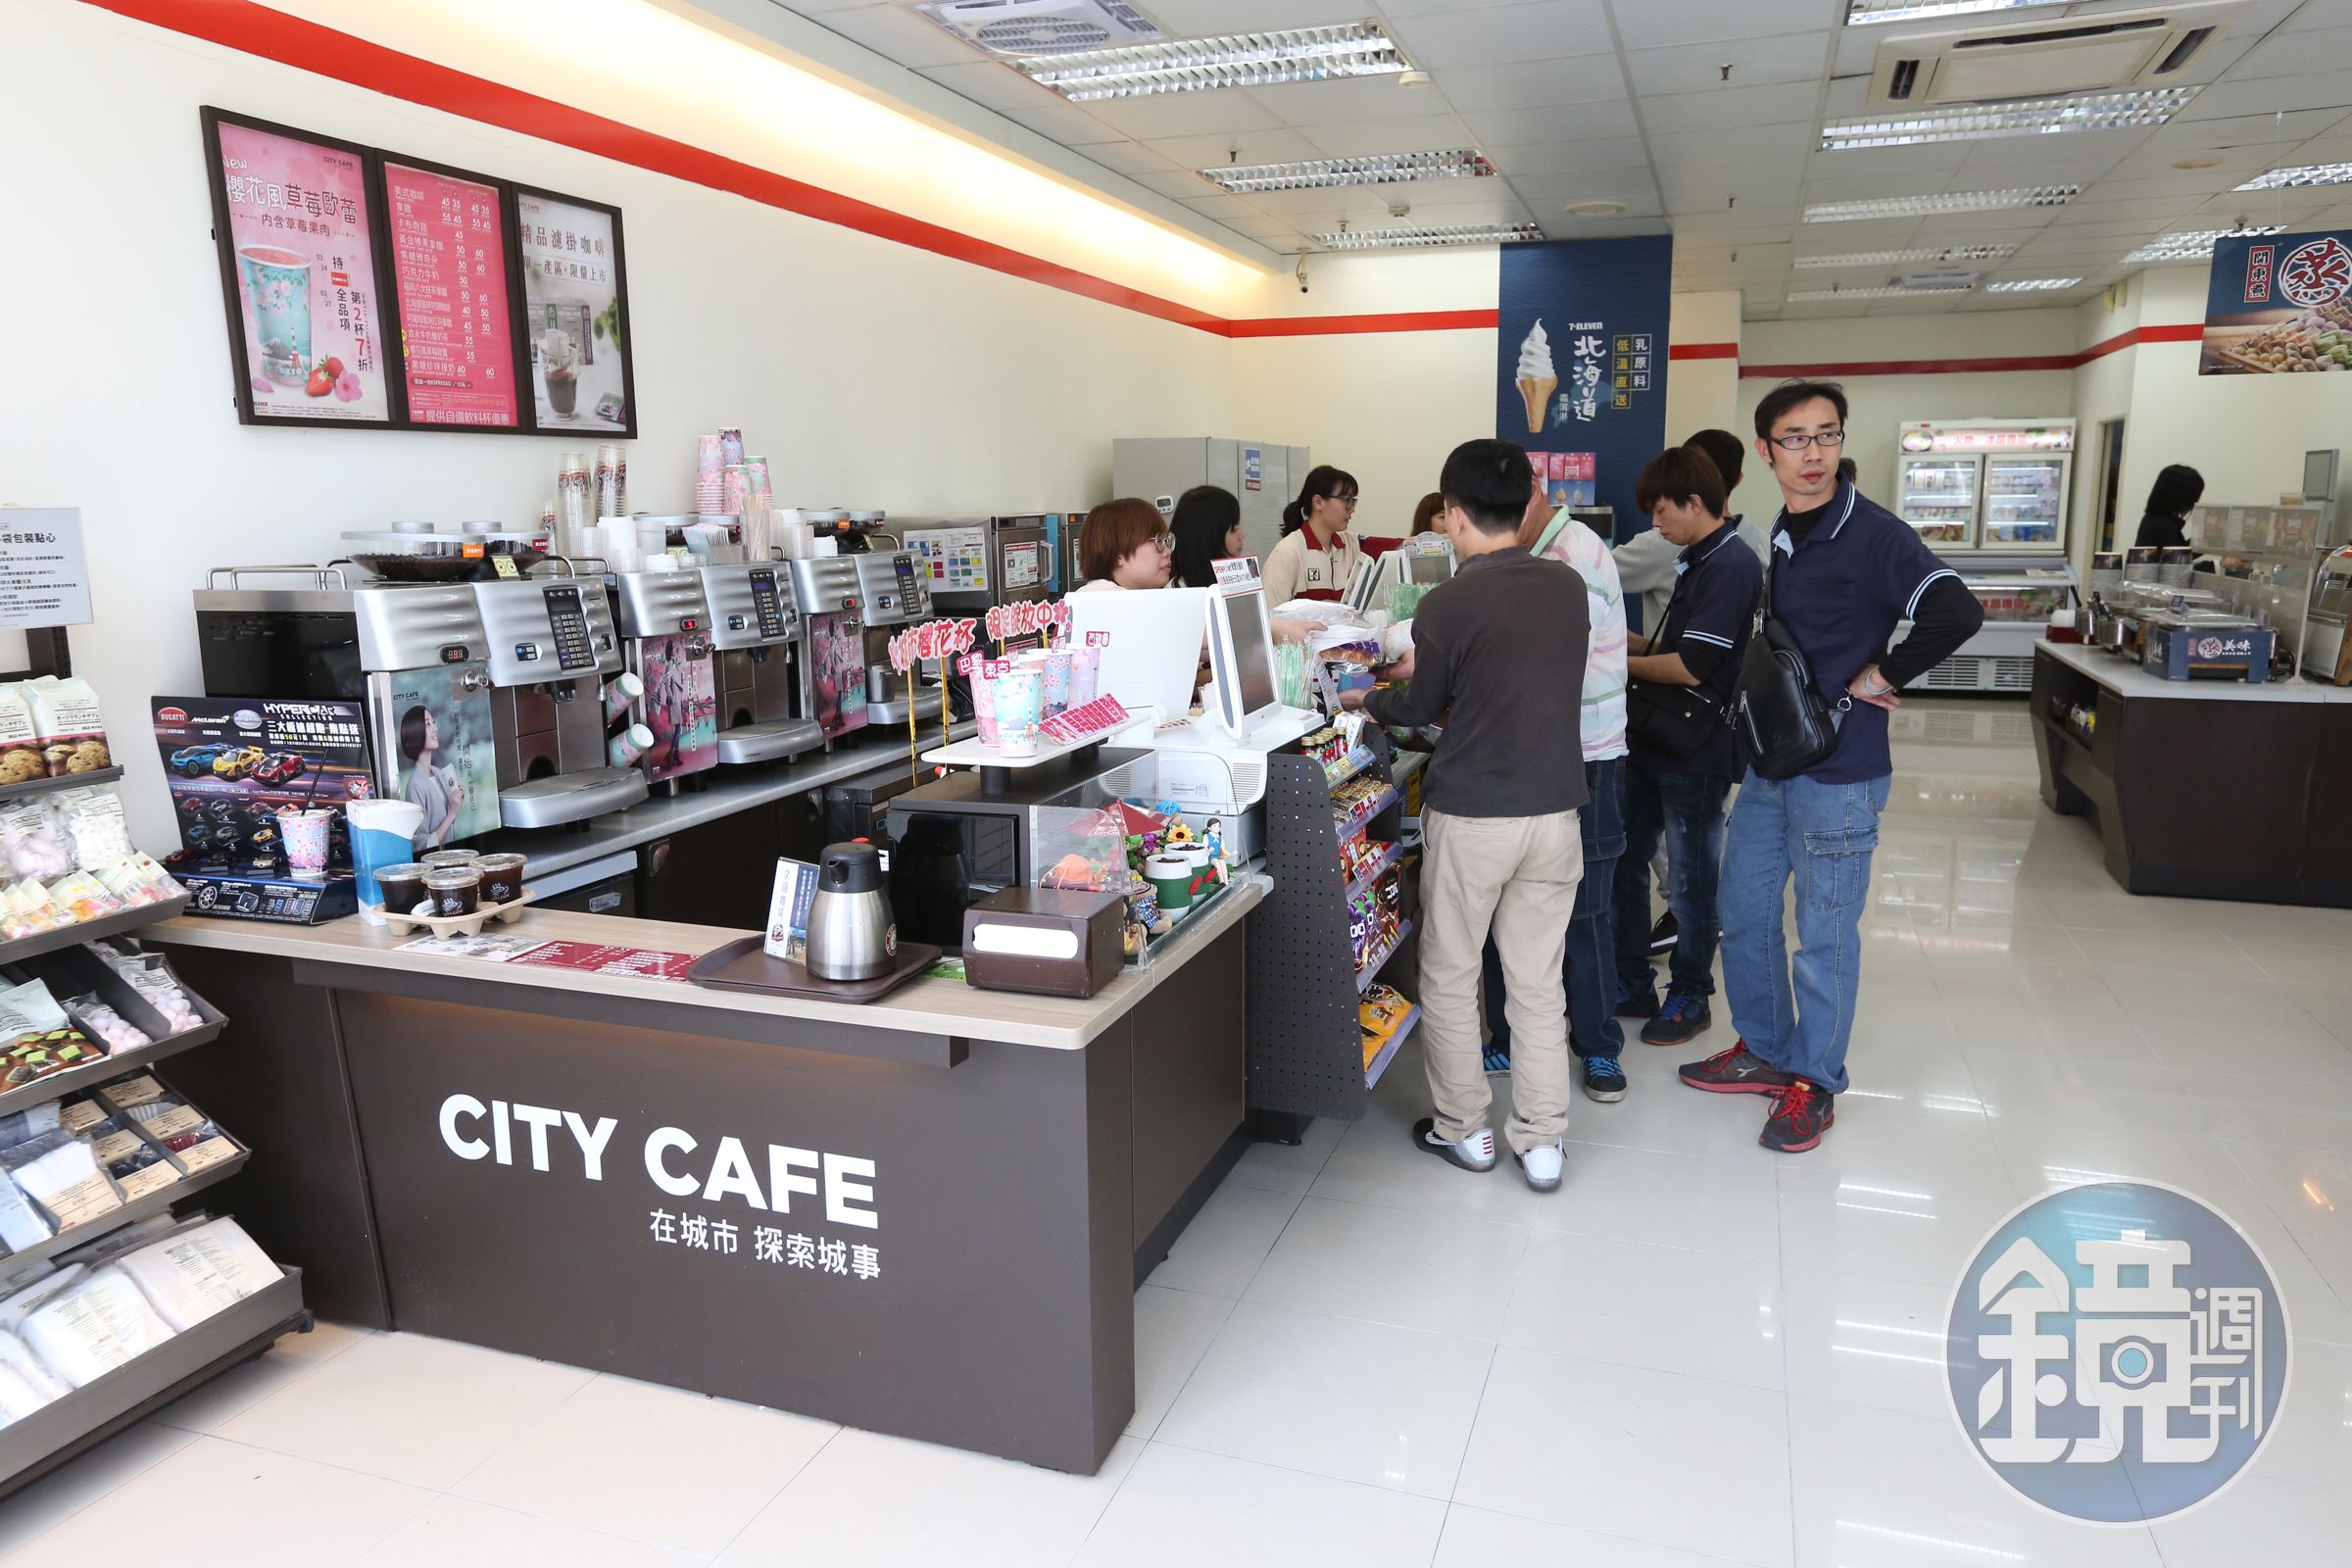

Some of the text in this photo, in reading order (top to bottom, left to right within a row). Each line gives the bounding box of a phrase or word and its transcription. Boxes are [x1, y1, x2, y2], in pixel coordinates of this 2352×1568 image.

[337, 288, 351, 331] 全品項
[351, 291, 368, 371] 第2杯7折
[1572, 335, 1607, 421] 北海道
[1614, 339, 1629, 407] 低溫直送
[1634, 336, 1648, 388] 乳原料
[0, 532, 57, 544] 袋包裝點心
[984, 662, 1010, 677] 東京
[439, 1094, 879, 1229] CITY CAFE
[650, 1207, 881, 1281] 在城市 探索城事
